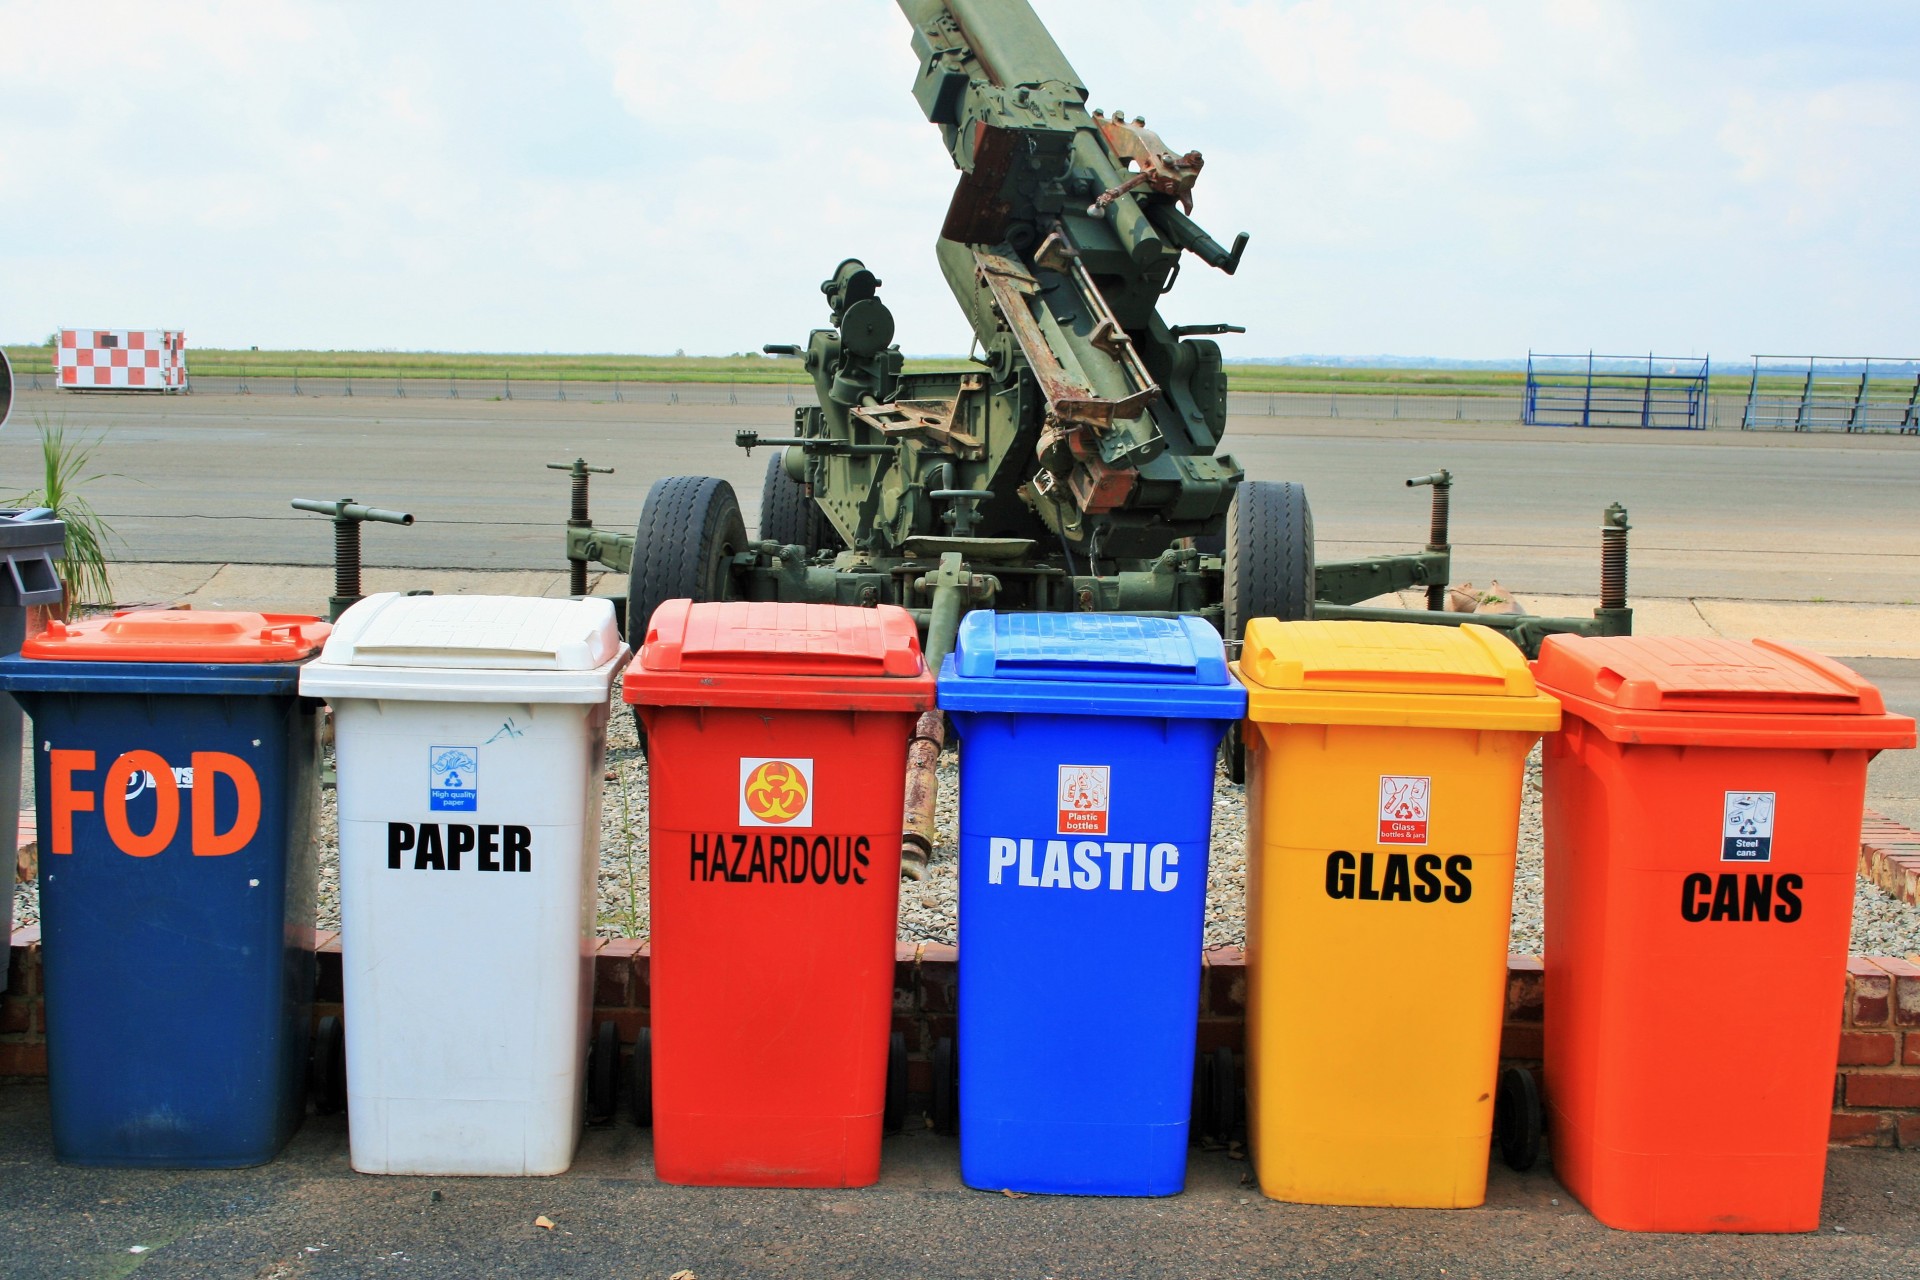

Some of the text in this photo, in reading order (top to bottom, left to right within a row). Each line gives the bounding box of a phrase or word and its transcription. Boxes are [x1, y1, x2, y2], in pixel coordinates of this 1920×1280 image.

[51, 749, 261, 857] FOD
[432, 790, 476, 800] High quality
[1068, 812, 1098, 821] Plastic
[387, 822, 532, 873] PAPER
[1066, 821, 1099, 830] bottles
[1391, 822, 1416, 831] Glass
[1735, 839, 1759, 848] Steel
[690, 833, 871, 885] HAZARDOUS
[988, 837, 1180, 893] PLASTIC
[1325, 850, 1473, 904] GLASS
[1681, 872, 1804, 924] CANS
